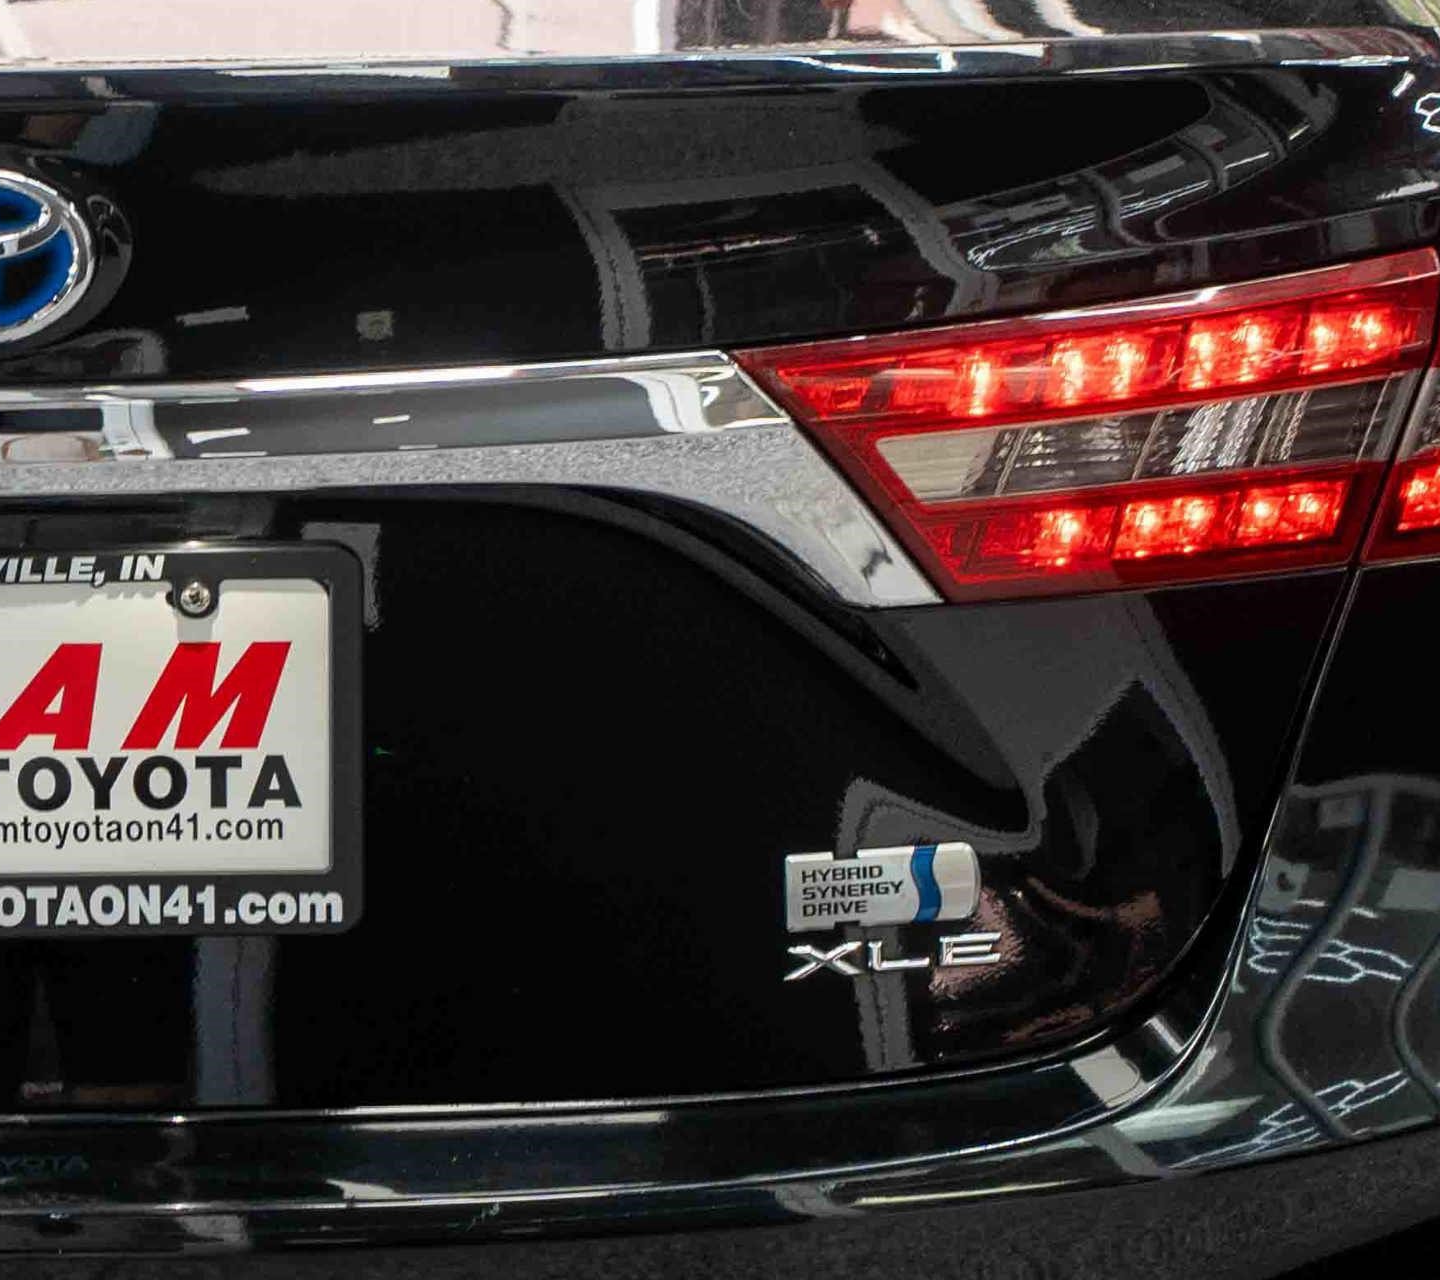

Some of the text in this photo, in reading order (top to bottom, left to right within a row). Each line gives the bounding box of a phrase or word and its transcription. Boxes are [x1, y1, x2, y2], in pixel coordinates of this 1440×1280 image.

[119, 555, 166, 580] IN
[801, 865, 884, 884] HYBRID
[801, 880, 905, 901] SYNERGY
[802, 900, 869, 918] DRIVE
[783, 931, 1002, 982] XLE
